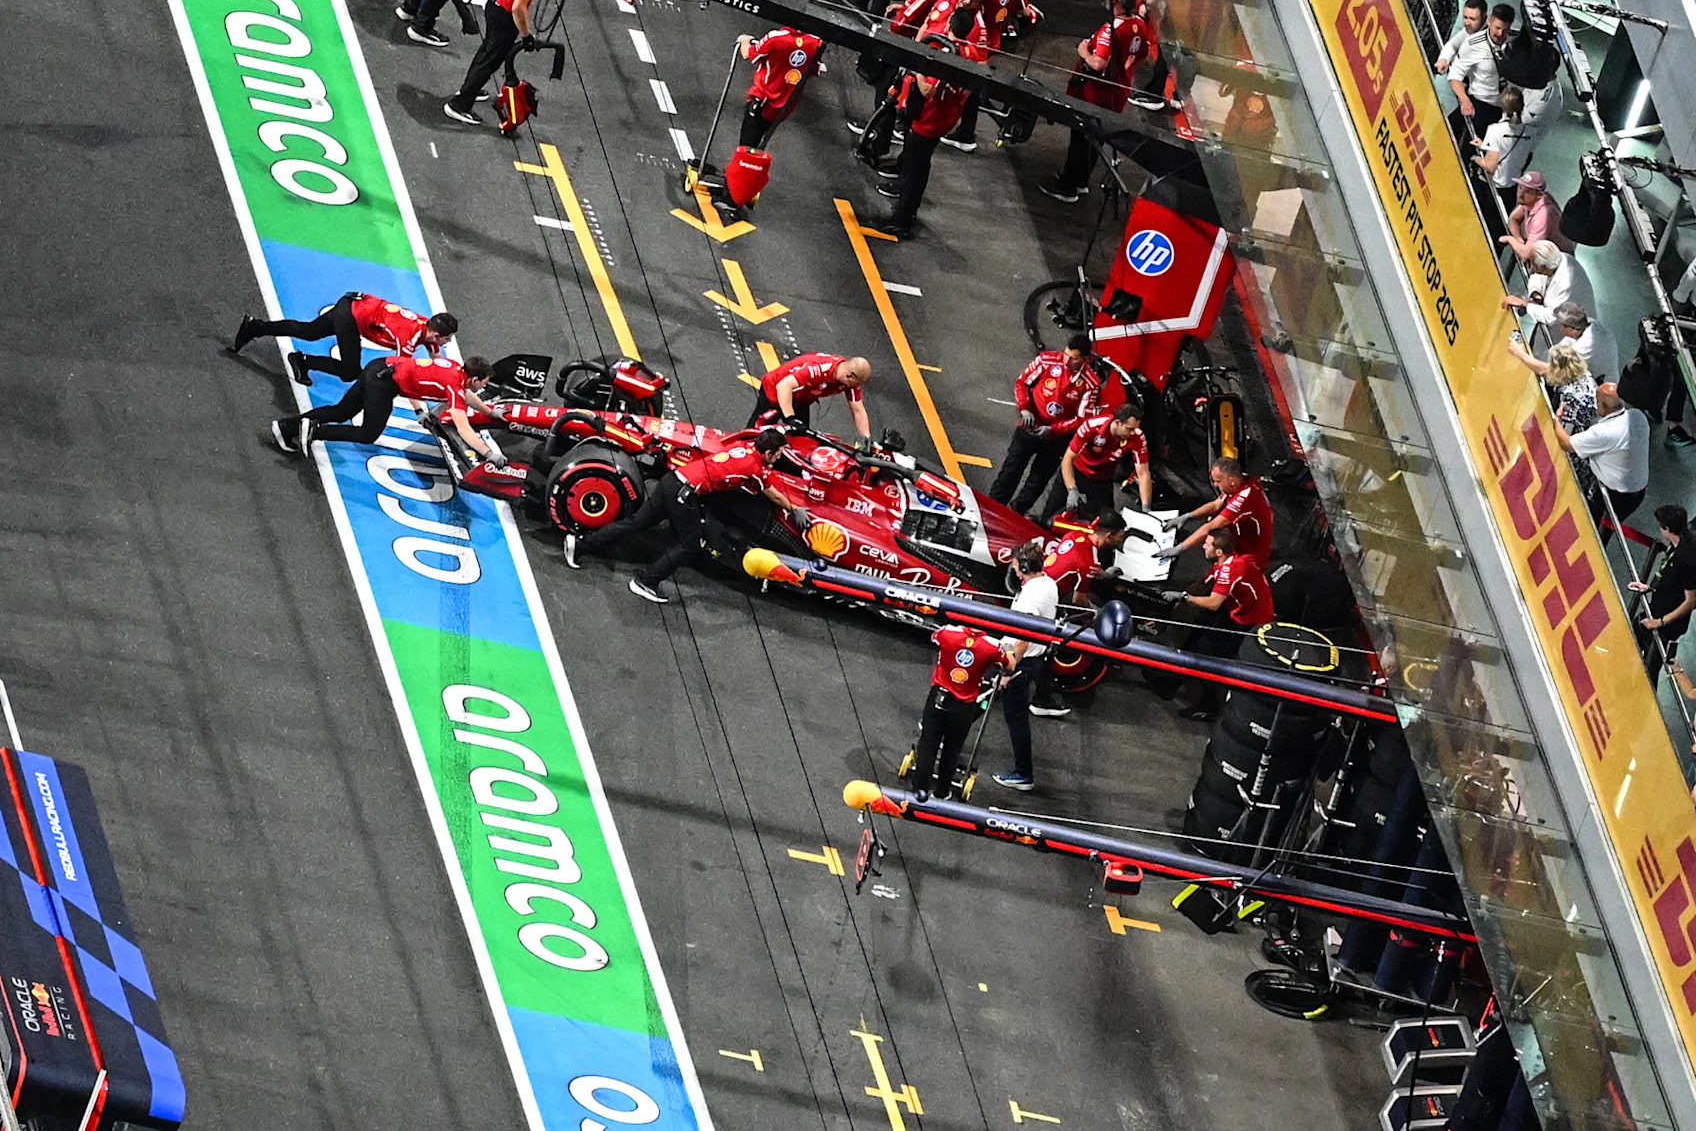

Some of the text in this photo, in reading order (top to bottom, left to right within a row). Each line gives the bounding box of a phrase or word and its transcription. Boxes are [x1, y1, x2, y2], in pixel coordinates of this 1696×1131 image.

[789, 50, 807, 67] hp
[1395, 88, 1432, 189] DHL
[1127, 230, 1174, 276] hp
[1375, 117, 1460, 347] FASTEST PIT STOP 2025
[515, 364, 546, 383] aws
[845, 496, 874, 518] IBM
[1499, 416, 1610, 707] DHL
[884, 586, 942, 608] ORACLE
[956, 649, 974, 667] hp
[35, 772, 77, 881] REDBULLRACING.COM
[442, 684, 608, 971] aramco
[985, 817, 1042, 838] ORACLE
[11, 976, 41, 1032] ORACLE
[52, 985, 77, 1041] RACING
